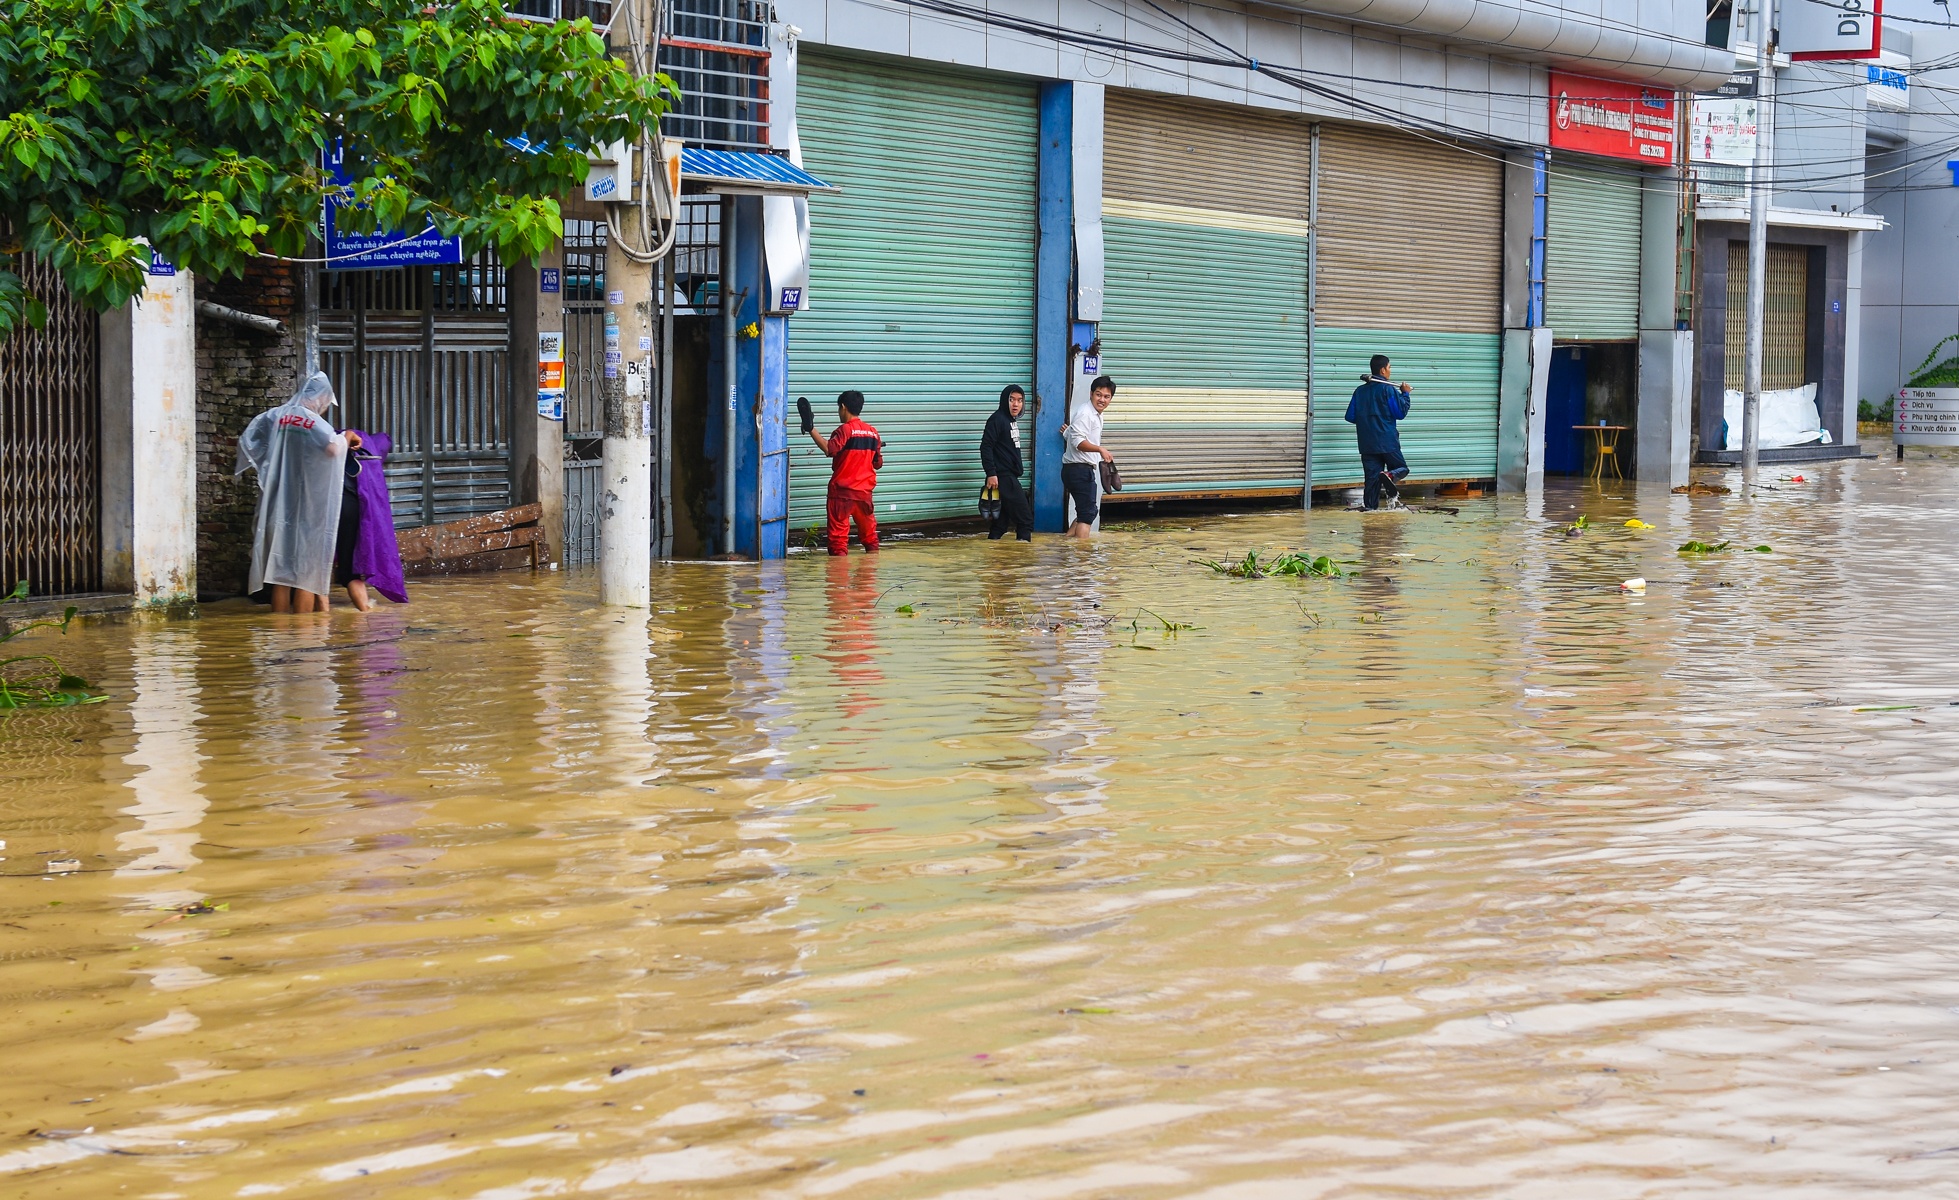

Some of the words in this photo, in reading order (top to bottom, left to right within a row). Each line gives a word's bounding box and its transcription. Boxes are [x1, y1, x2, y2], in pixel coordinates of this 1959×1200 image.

[543, 271, 557, 285] 765
[784, 290, 799, 302] 767
[1085, 357, 1097, 368] 769
[1912, 390, 1925, 398] Tiếp
[1926, 390, 1936, 398] tân
[1912, 401, 1925, 409] Dịch
[1912, 413, 1923, 421] Phụ
[1924, 413, 1938, 422] tùng
[1911, 424, 1922, 432] Khu
[1936, 424, 1947, 433] đậu
